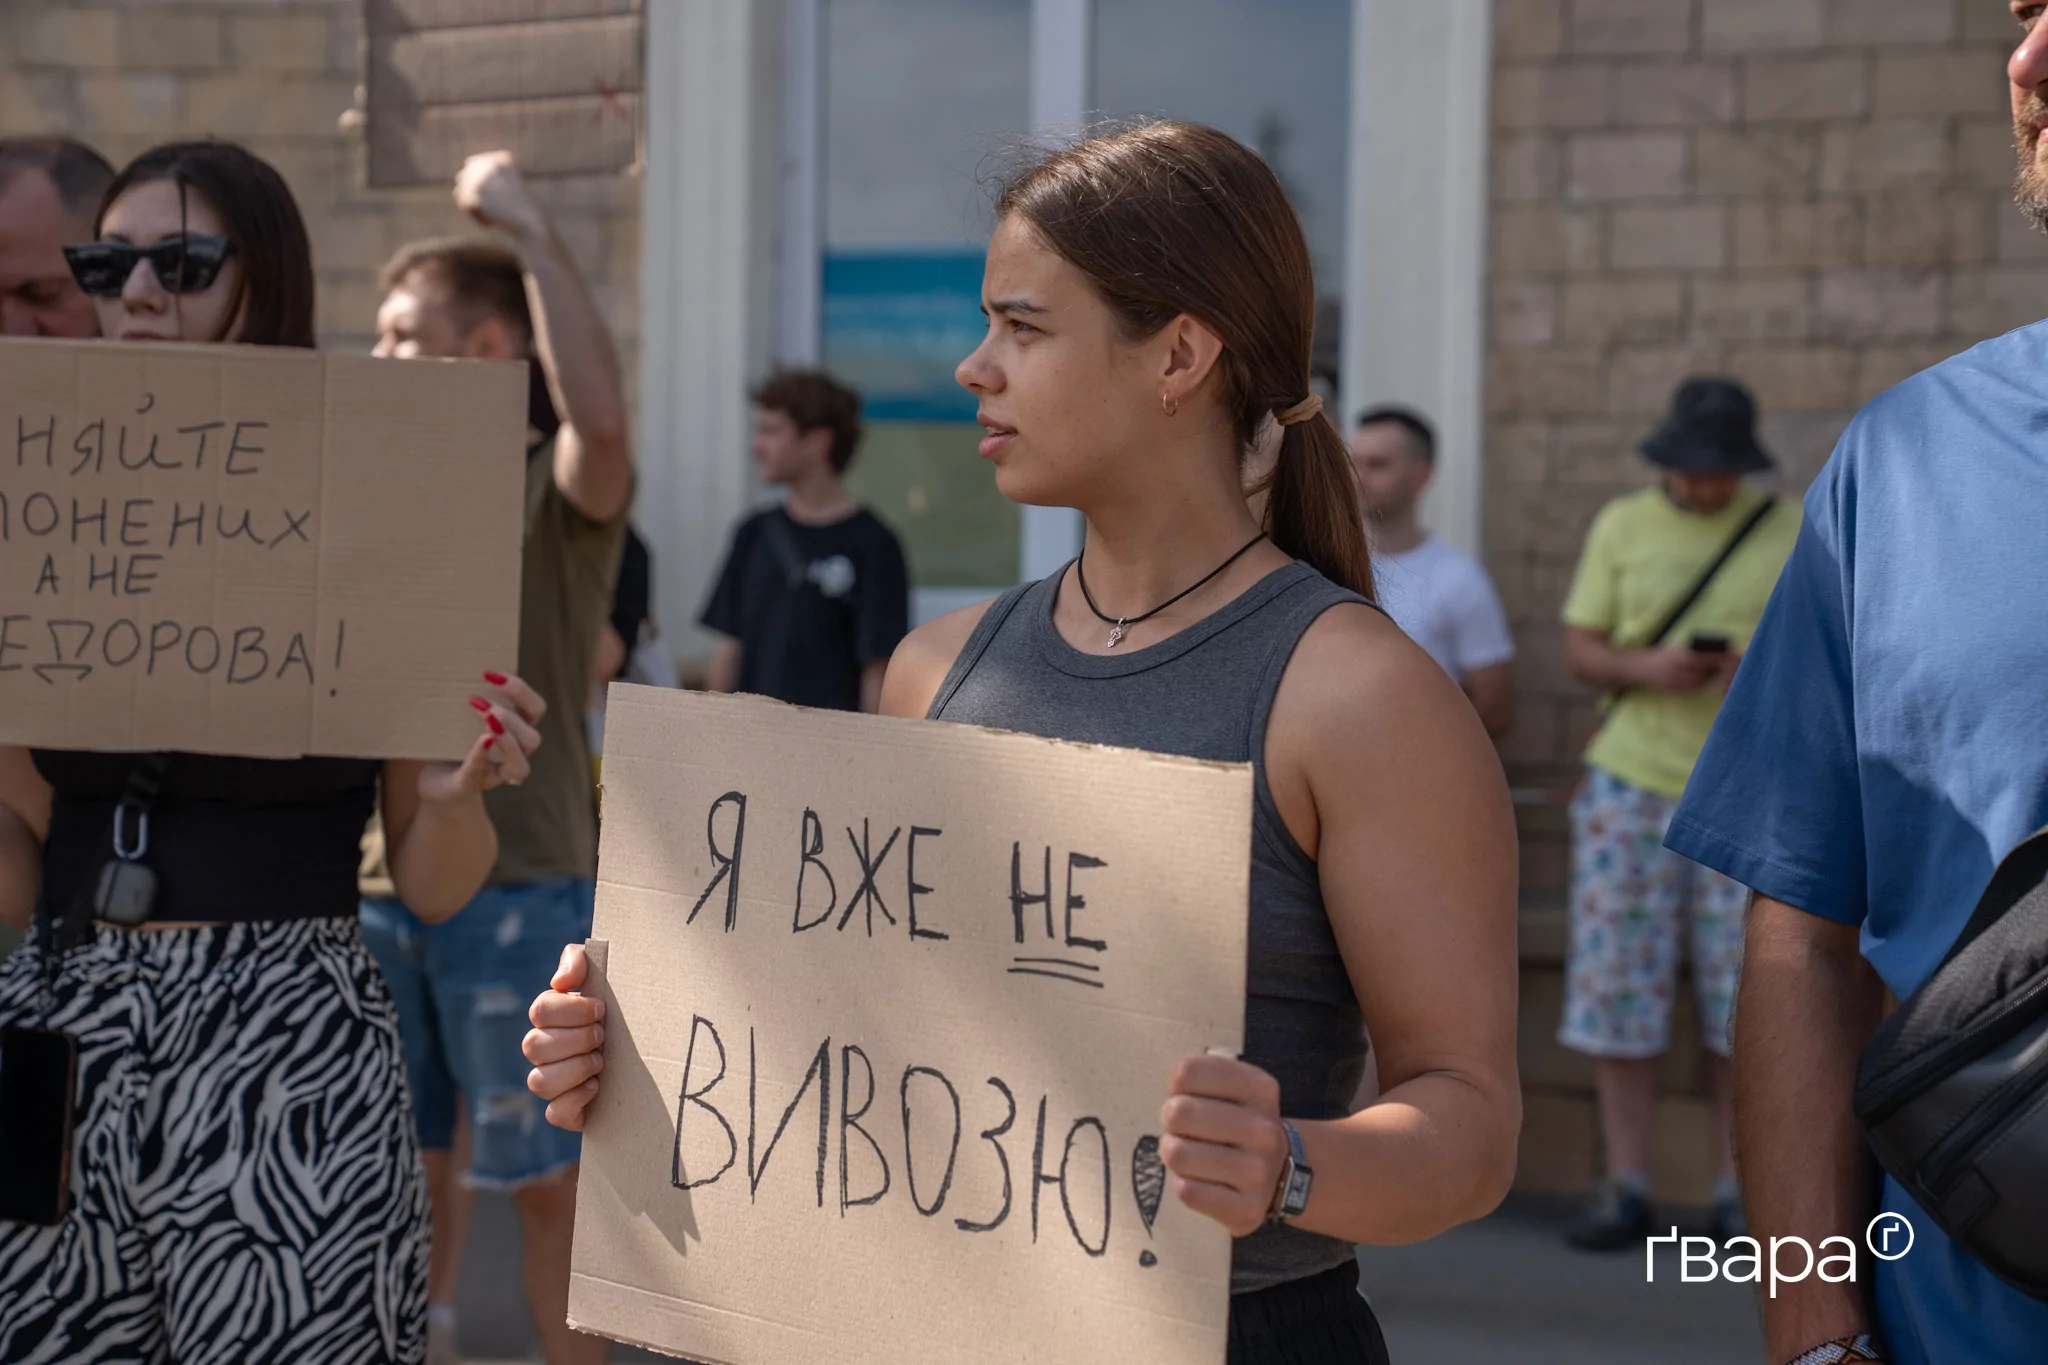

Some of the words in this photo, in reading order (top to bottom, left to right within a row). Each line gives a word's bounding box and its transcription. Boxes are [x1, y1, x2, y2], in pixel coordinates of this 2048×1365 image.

[34, 552, 59, 595] А
[88, 553, 164, 597] НЕ
[686, 791, 747, 933] Я
[792, 806, 949, 941] ВЖЕ
[1008, 840, 1109, 951] НЕ
[671, 1013, 1167, 1267] ВИВОЗЮ!
